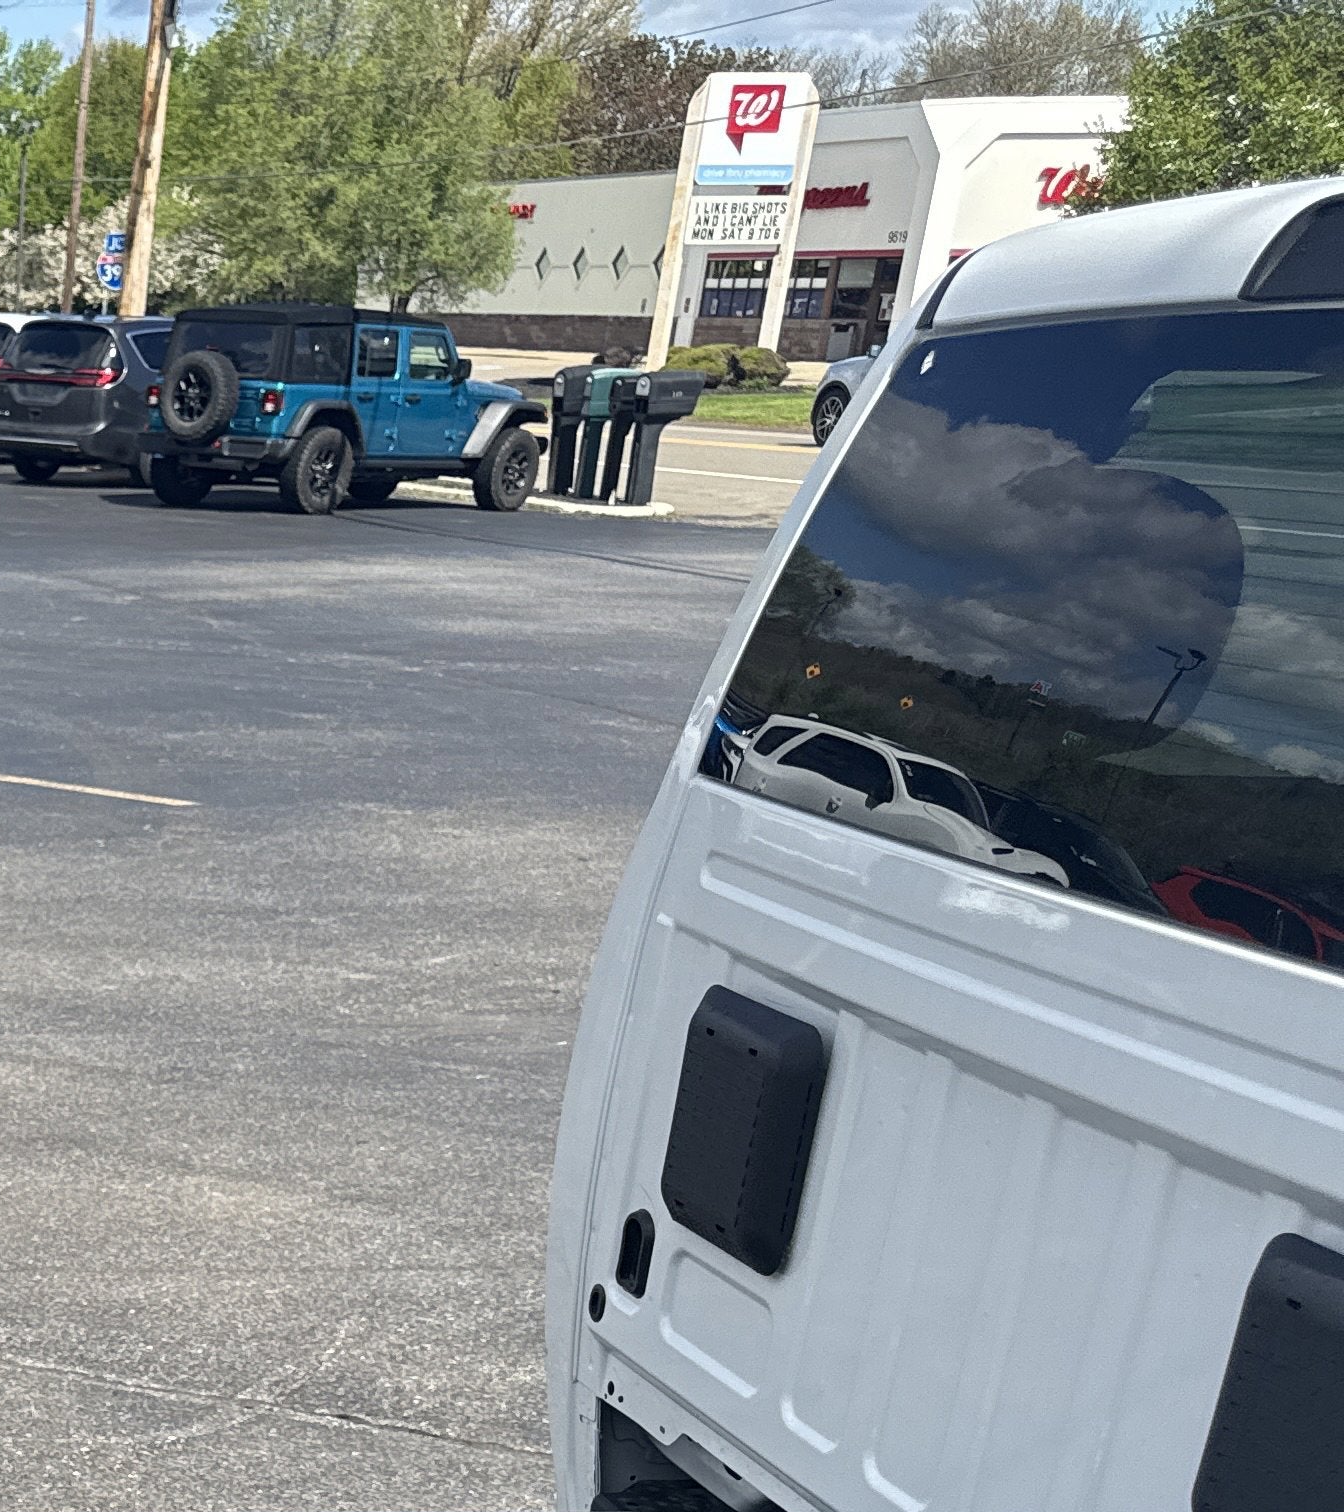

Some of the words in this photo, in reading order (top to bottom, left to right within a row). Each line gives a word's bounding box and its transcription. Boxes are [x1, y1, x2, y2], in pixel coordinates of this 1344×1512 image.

[733, 89, 780, 127] W
[703, 202, 729, 214] LIKE
[730, 202, 750, 214] BIG
[751, 202, 788, 215] SHOTS
[694, 215, 720, 227] AND
[729, 215, 759, 227] CANT
[762, 215, 780, 227] LIE
[691, 228, 715, 240] MON
[720, 228, 744, 240] SAT
[747, 228, 755, 240] 9
[773, 228, 781, 240] 6
[101, 264, 123, 282] 39
